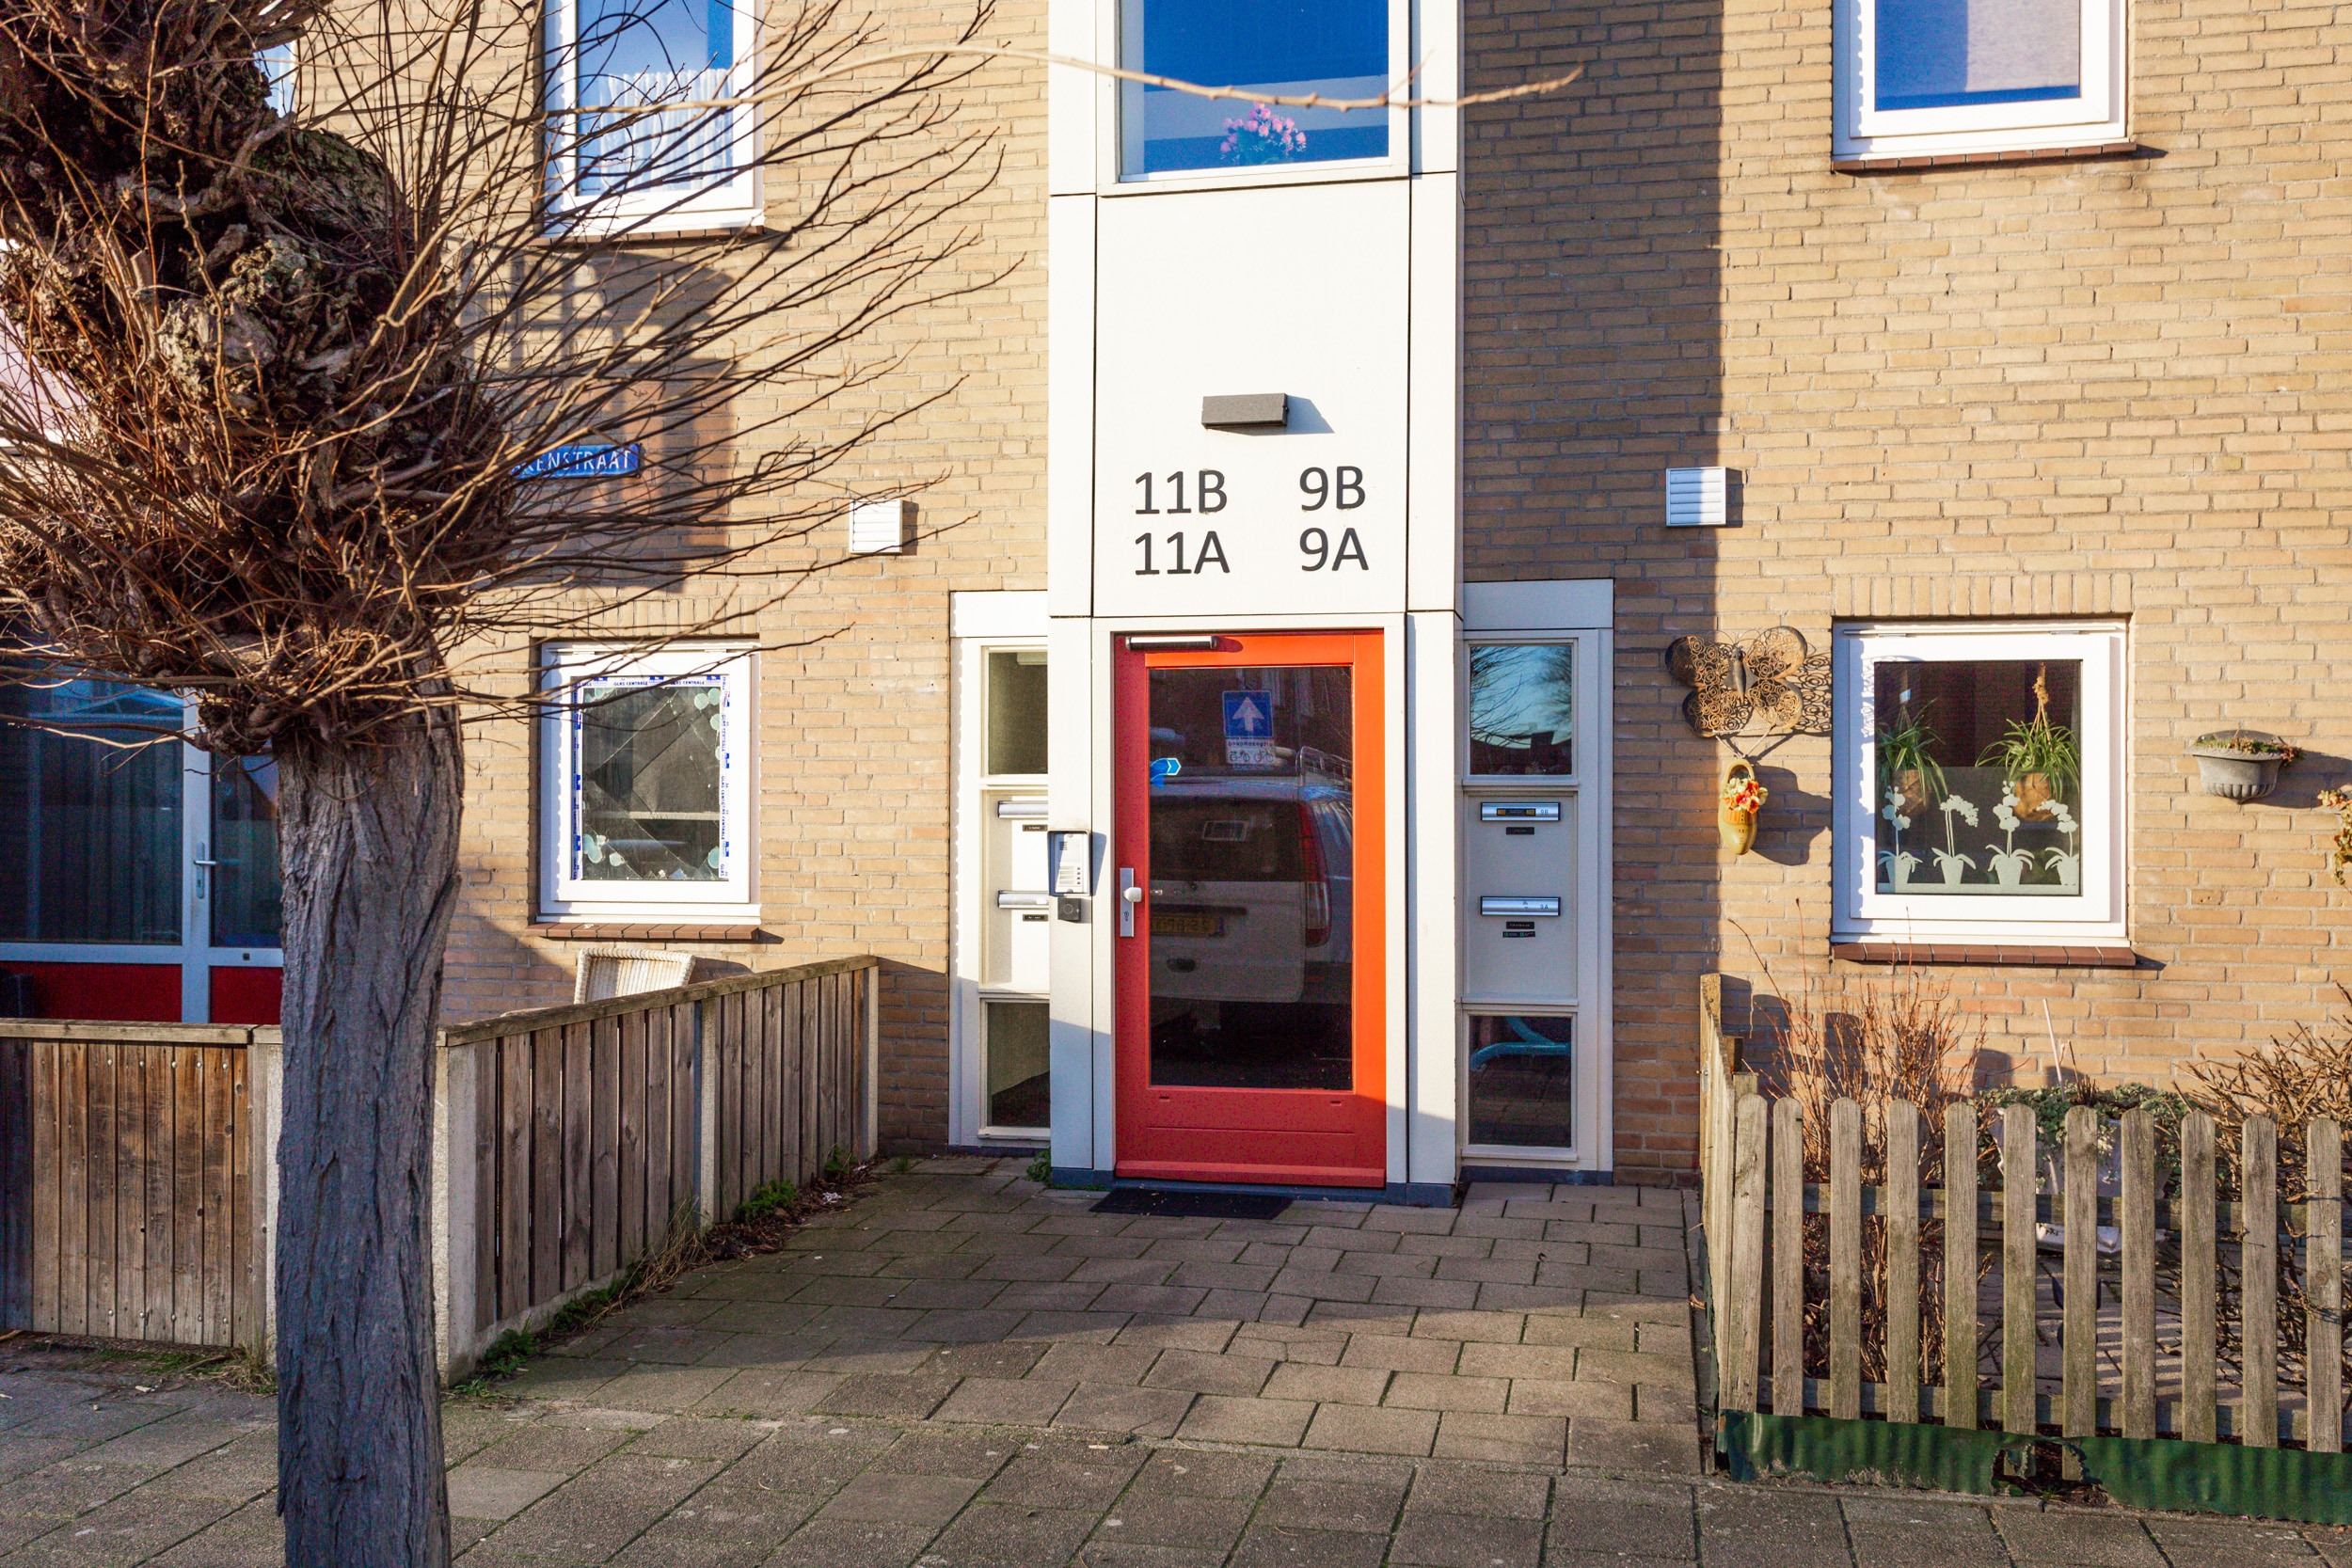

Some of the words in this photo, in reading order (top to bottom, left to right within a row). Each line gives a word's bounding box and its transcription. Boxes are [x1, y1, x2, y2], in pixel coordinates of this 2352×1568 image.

[1135, 468, 1228, 515] 11B
[1299, 466, 1366, 511] 9B
[1135, 531, 1231, 575] 11A
[1299, 527, 1369, 571] 9A
